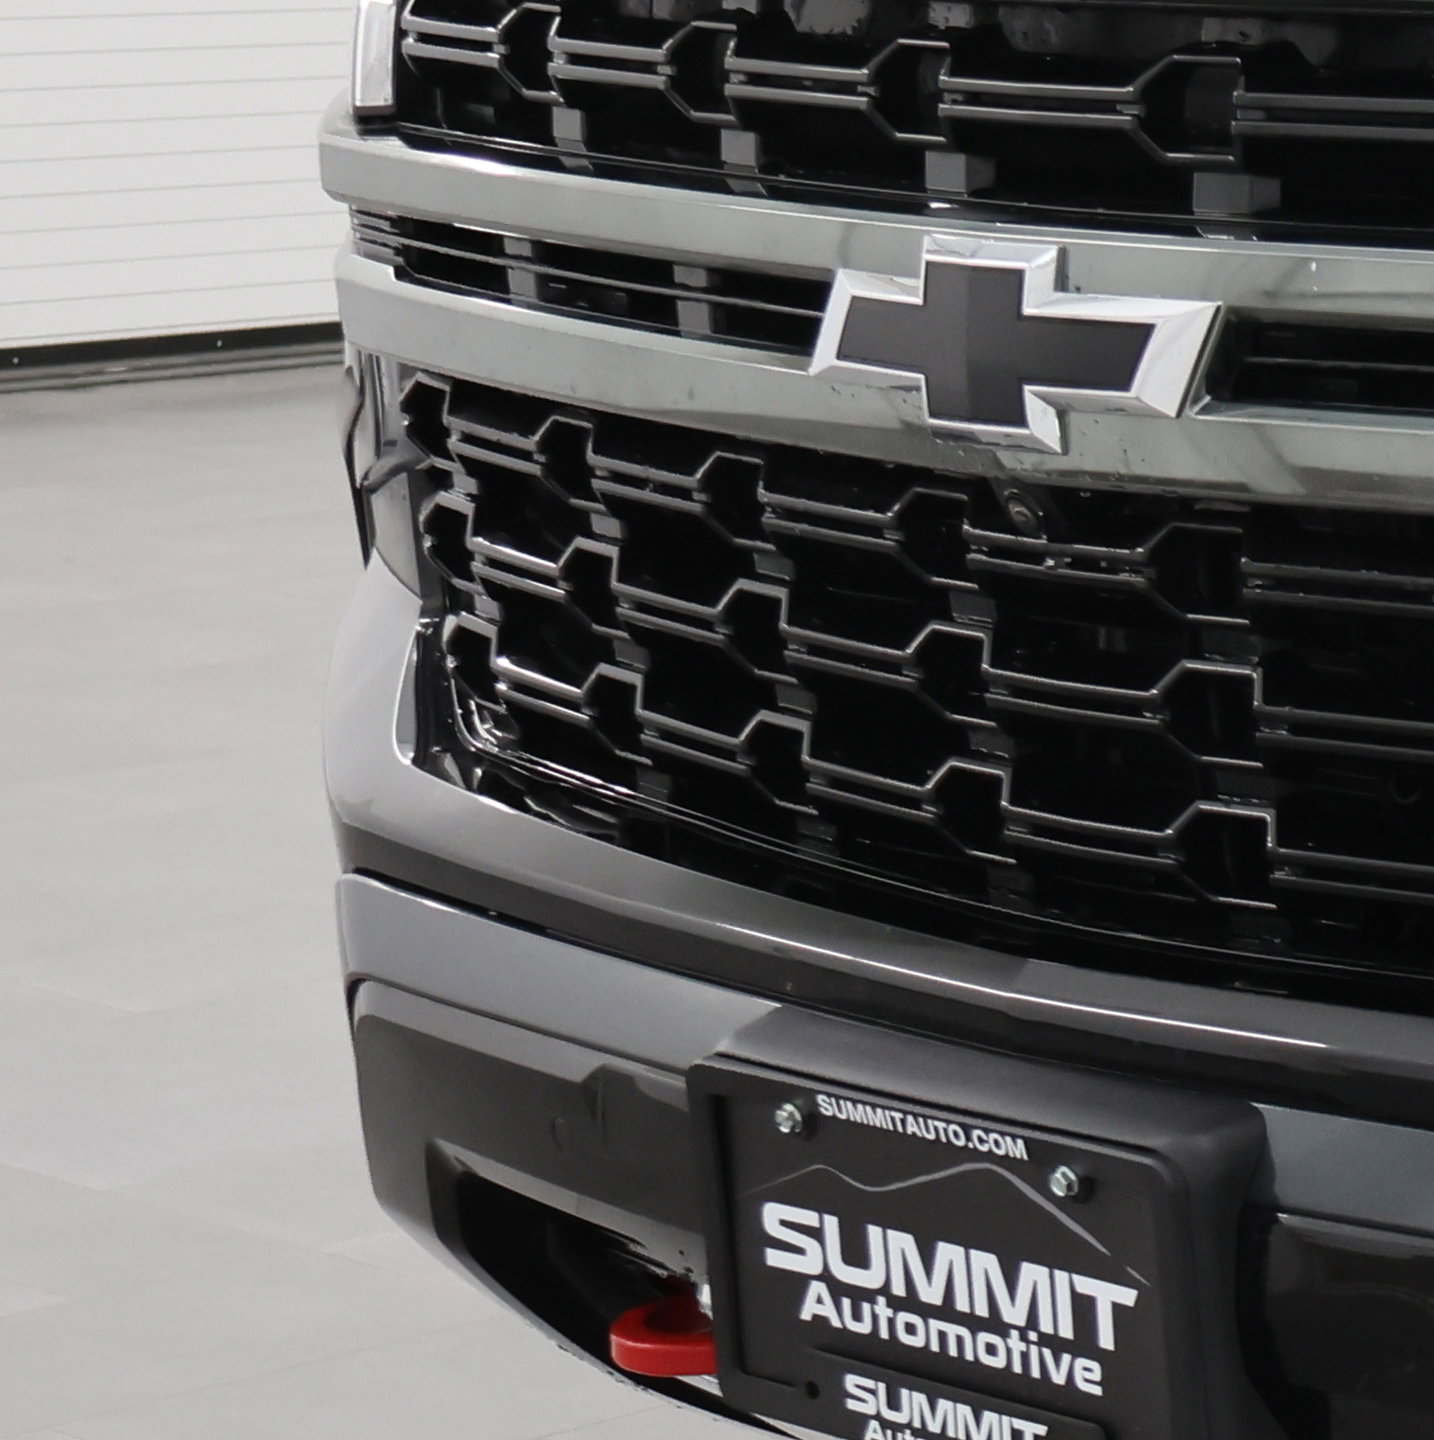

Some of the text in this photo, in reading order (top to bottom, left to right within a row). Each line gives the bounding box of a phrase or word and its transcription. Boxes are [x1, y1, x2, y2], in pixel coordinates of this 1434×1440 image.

[815, 1093, 1029, 1161] SUMMITAUTO.COM
[760, 1201, 1139, 1352] SUMMIT
[799, 1279, 1104, 1397] Automotive
